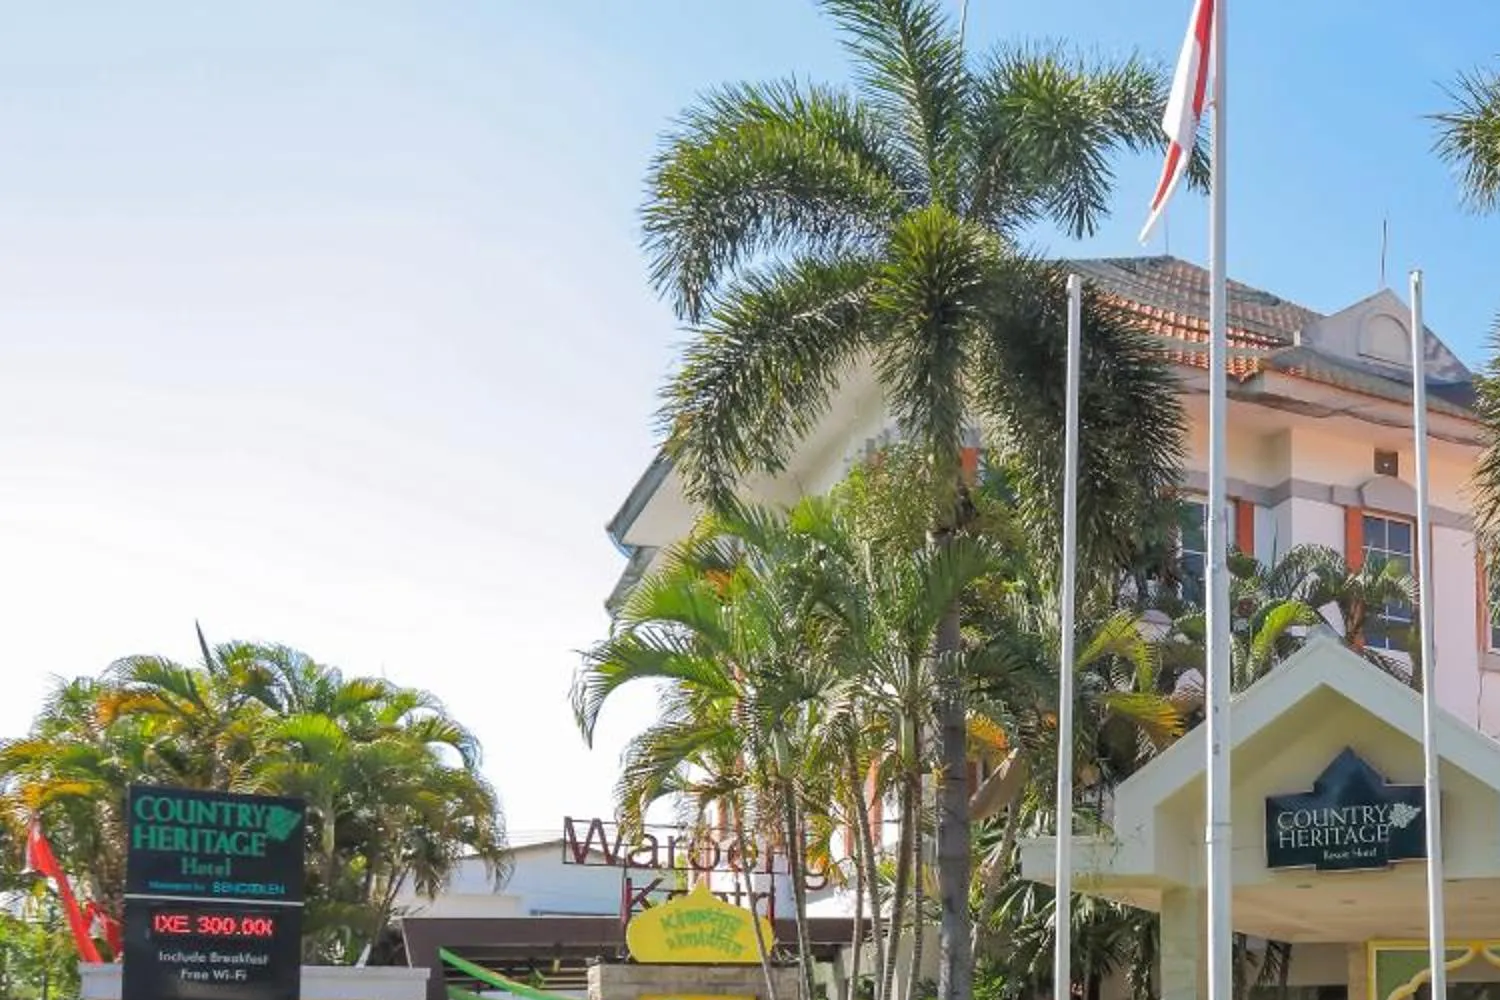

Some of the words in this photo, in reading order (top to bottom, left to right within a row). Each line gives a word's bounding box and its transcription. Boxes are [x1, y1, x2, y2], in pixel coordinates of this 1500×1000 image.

[133, 795, 267, 828] COUNTRY
[1277, 803, 1389, 830] COUNTRY
[132, 824, 267, 857] HERITAGE
[1279, 824, 1390, 848] HERITAGE
[181, 856, 232, 876] Hotel
[158, 951, 206, 963] Include
[209, 952, 269, 965] Breakfast
[180, 969, 209, 980] Free
[213, 969, 248, 981] Wi-Fi
